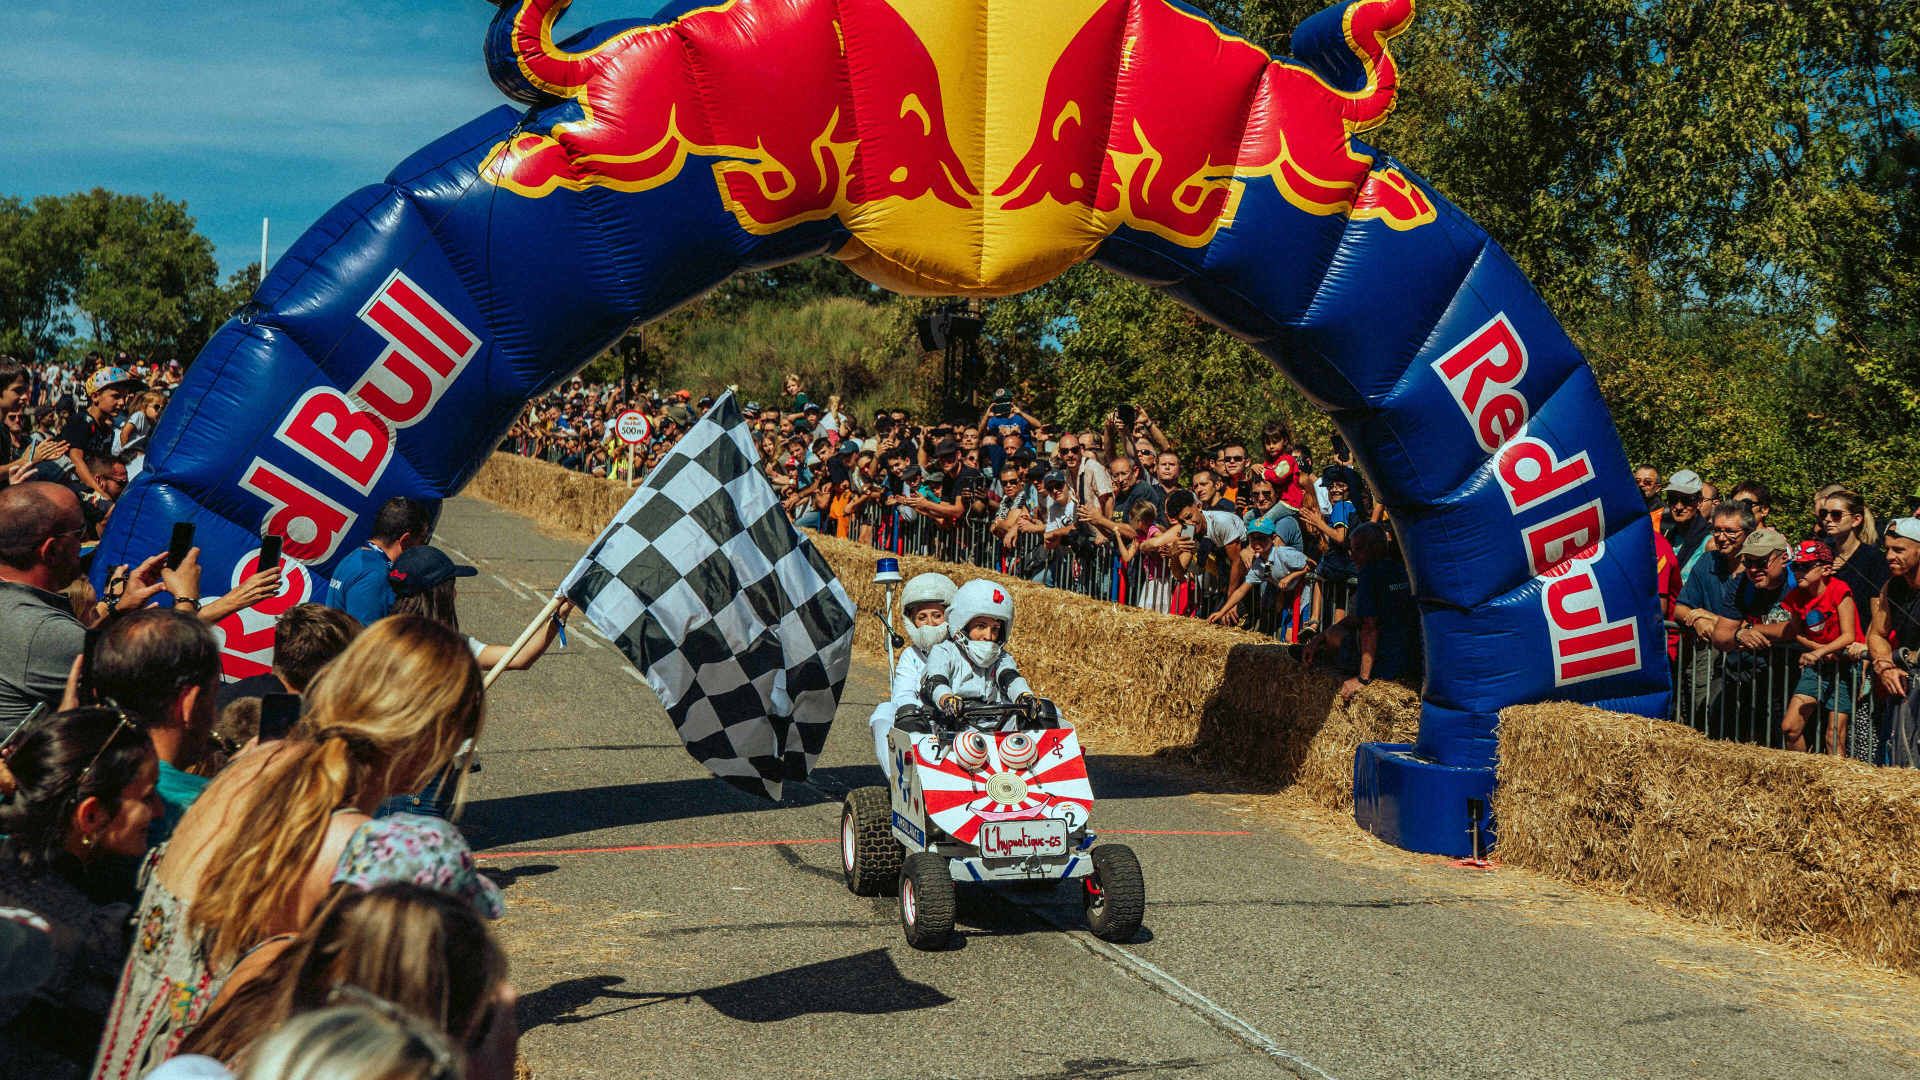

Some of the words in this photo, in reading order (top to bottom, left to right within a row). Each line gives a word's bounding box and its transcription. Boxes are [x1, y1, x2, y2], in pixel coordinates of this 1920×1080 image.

[275, 270, 481, 495] Bull
[1432, 312, 1594, 514] Red
[1522, 498, 1641, 686] Bull
[931, 744, 942, 760] 2
[1064, 811, 1078, 827] 2
